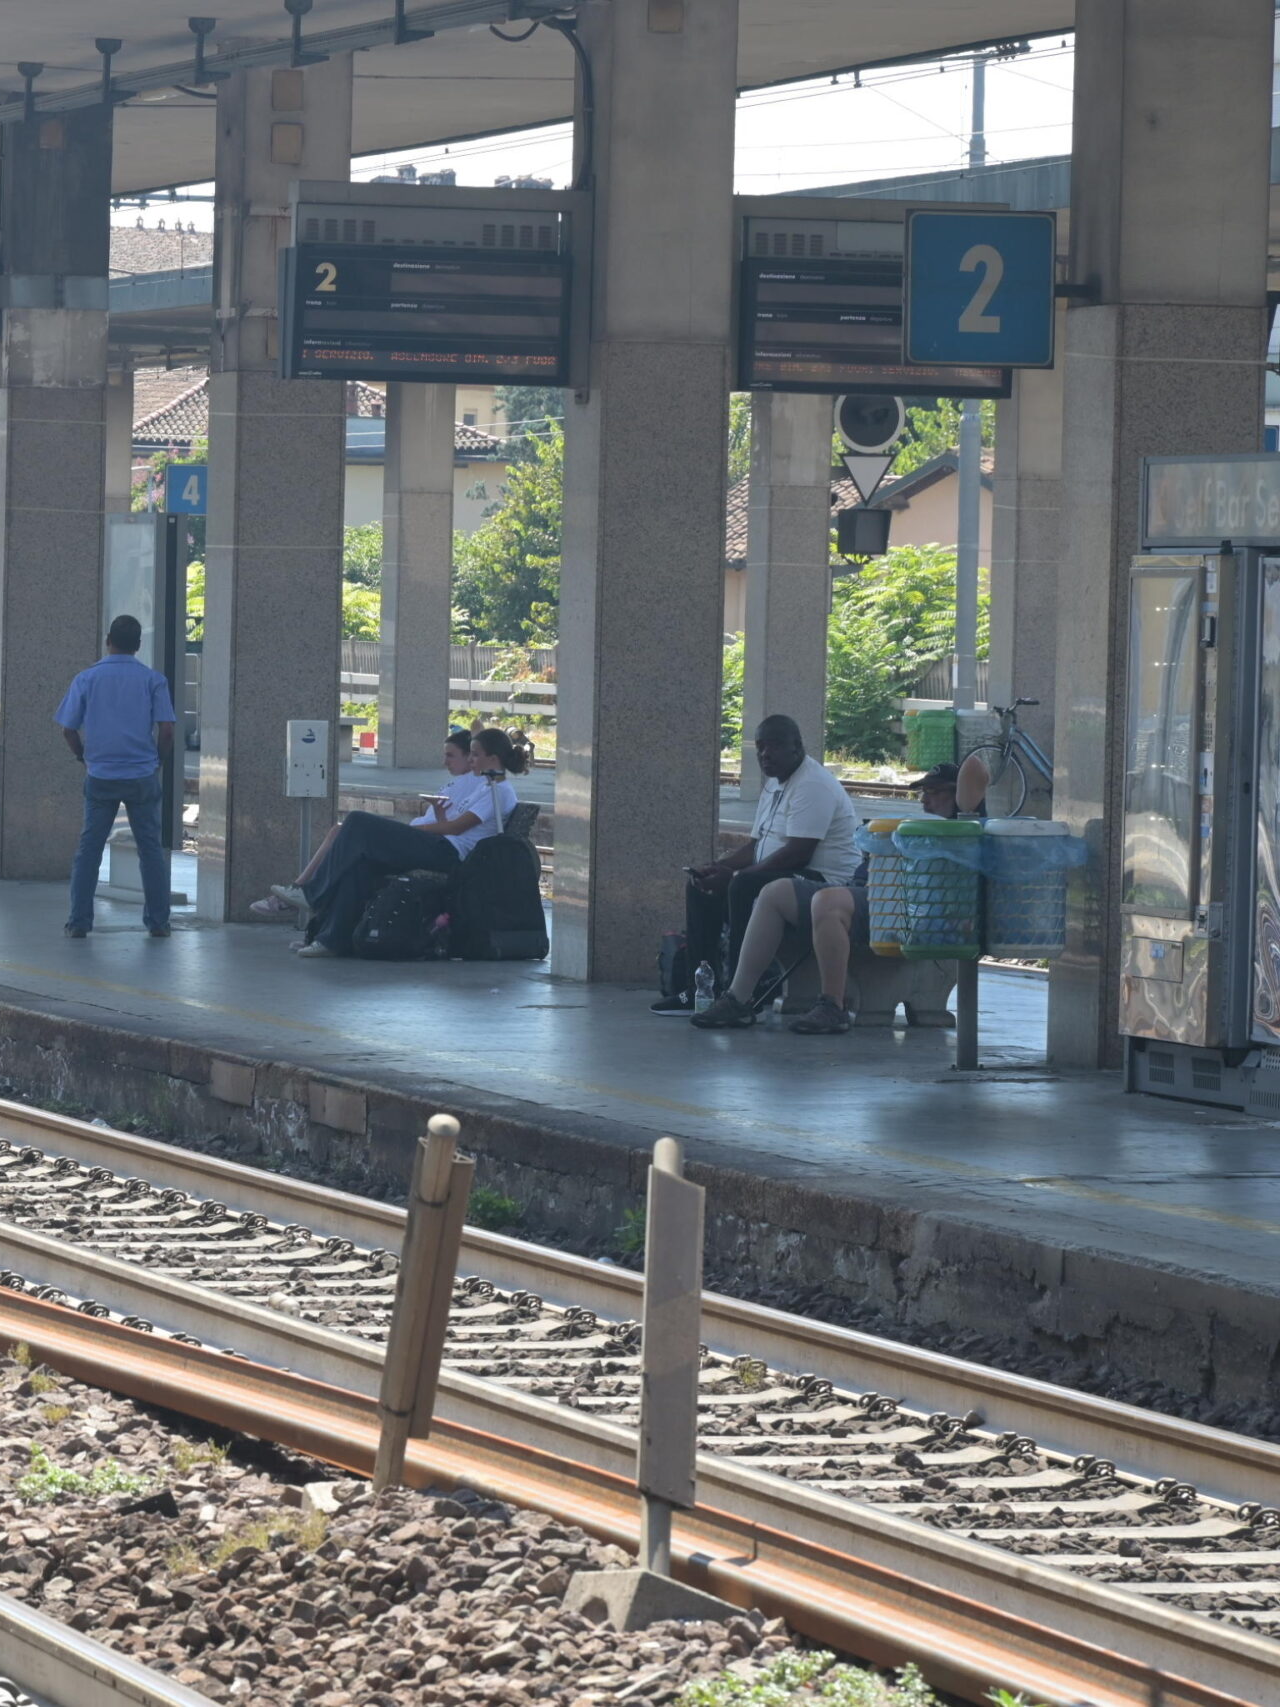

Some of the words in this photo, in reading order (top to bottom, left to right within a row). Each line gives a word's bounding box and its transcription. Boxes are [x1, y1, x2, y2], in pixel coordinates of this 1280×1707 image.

[315, 262, 337, 292] 2
[958, 244, 1004, 333] 2
[182, 474, 200, 506] 4
[1216, 480, 1249, 529] Bar
